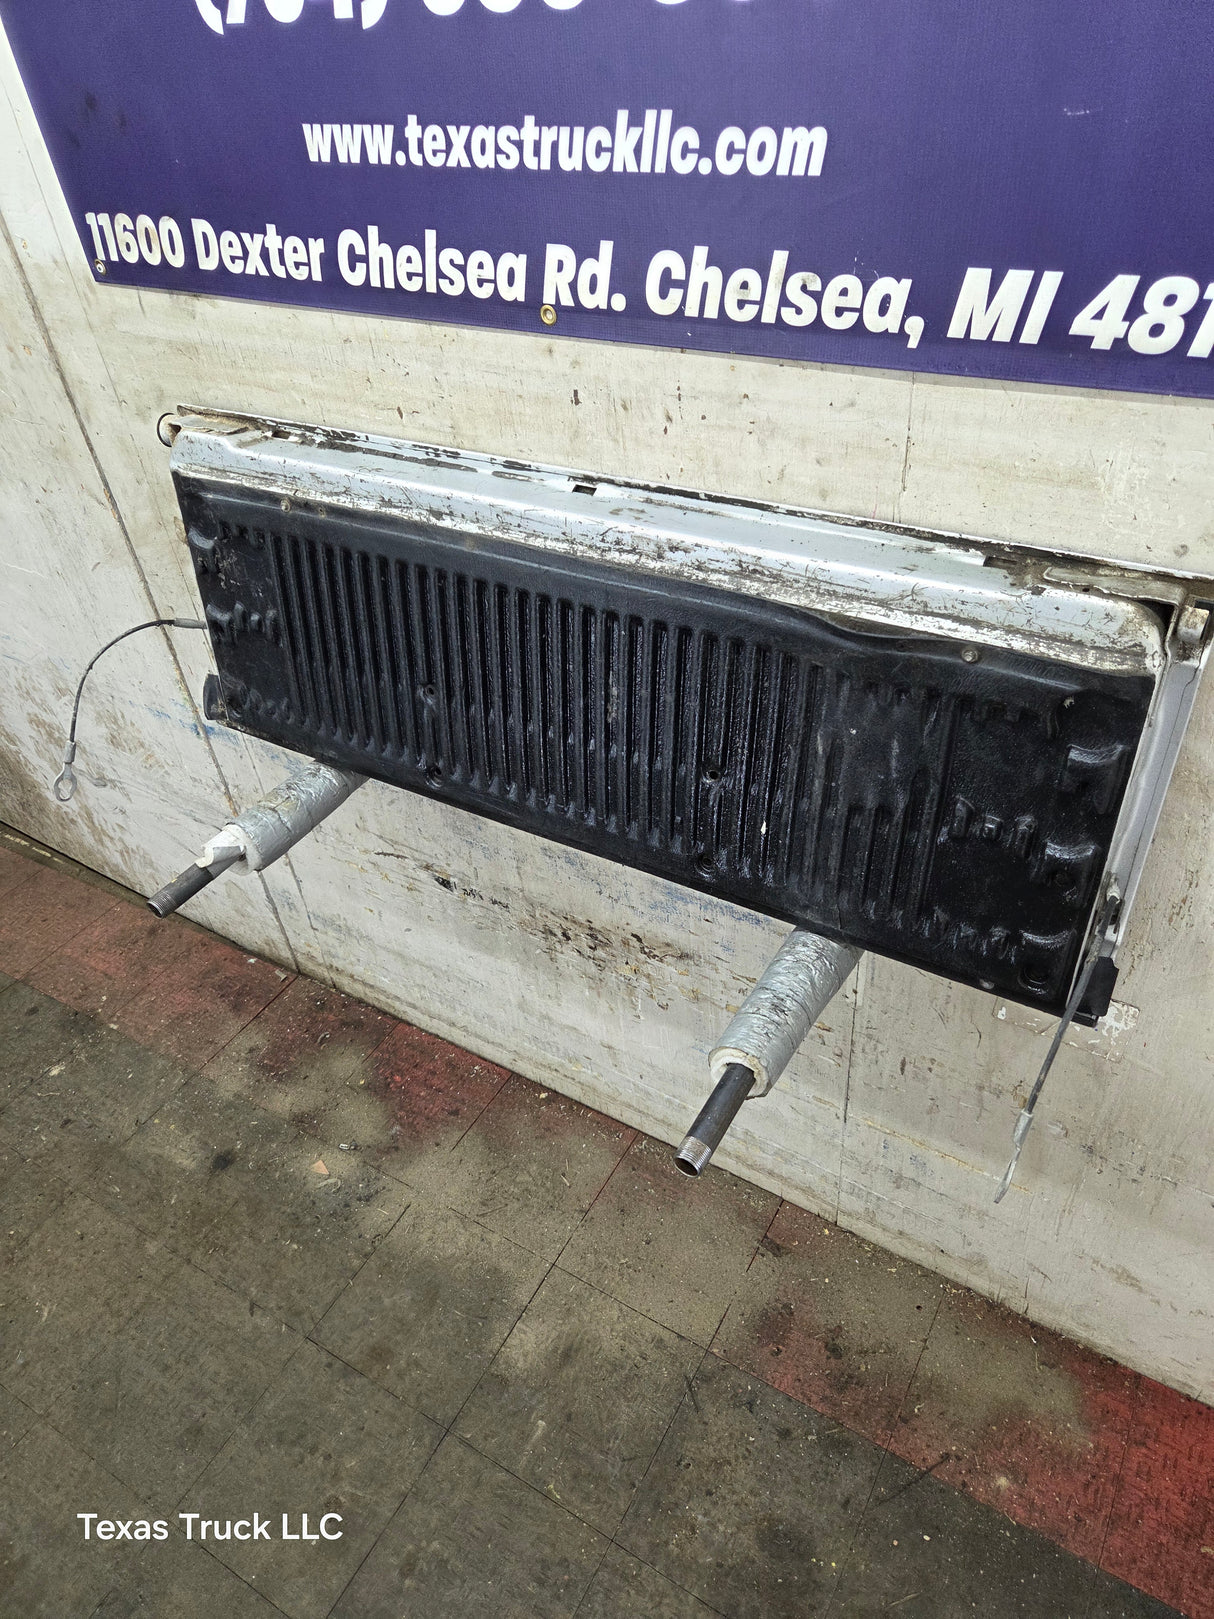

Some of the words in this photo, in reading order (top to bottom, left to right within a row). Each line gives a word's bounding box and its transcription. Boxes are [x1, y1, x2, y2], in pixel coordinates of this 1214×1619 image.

[301, 108, 828, 177] www.texastruckllc.com
[84, 212, 185, 268] 11600
[190, 218, 325, 282] Dexter
[337, 224, 528, 302] Chelsea
[542, 239, 627, 311] Rd.
[645, 245, 925, 349] Chelsea,
[946, 266, 1064, 345] MI
[1068, 273, 1214, 359] 481
